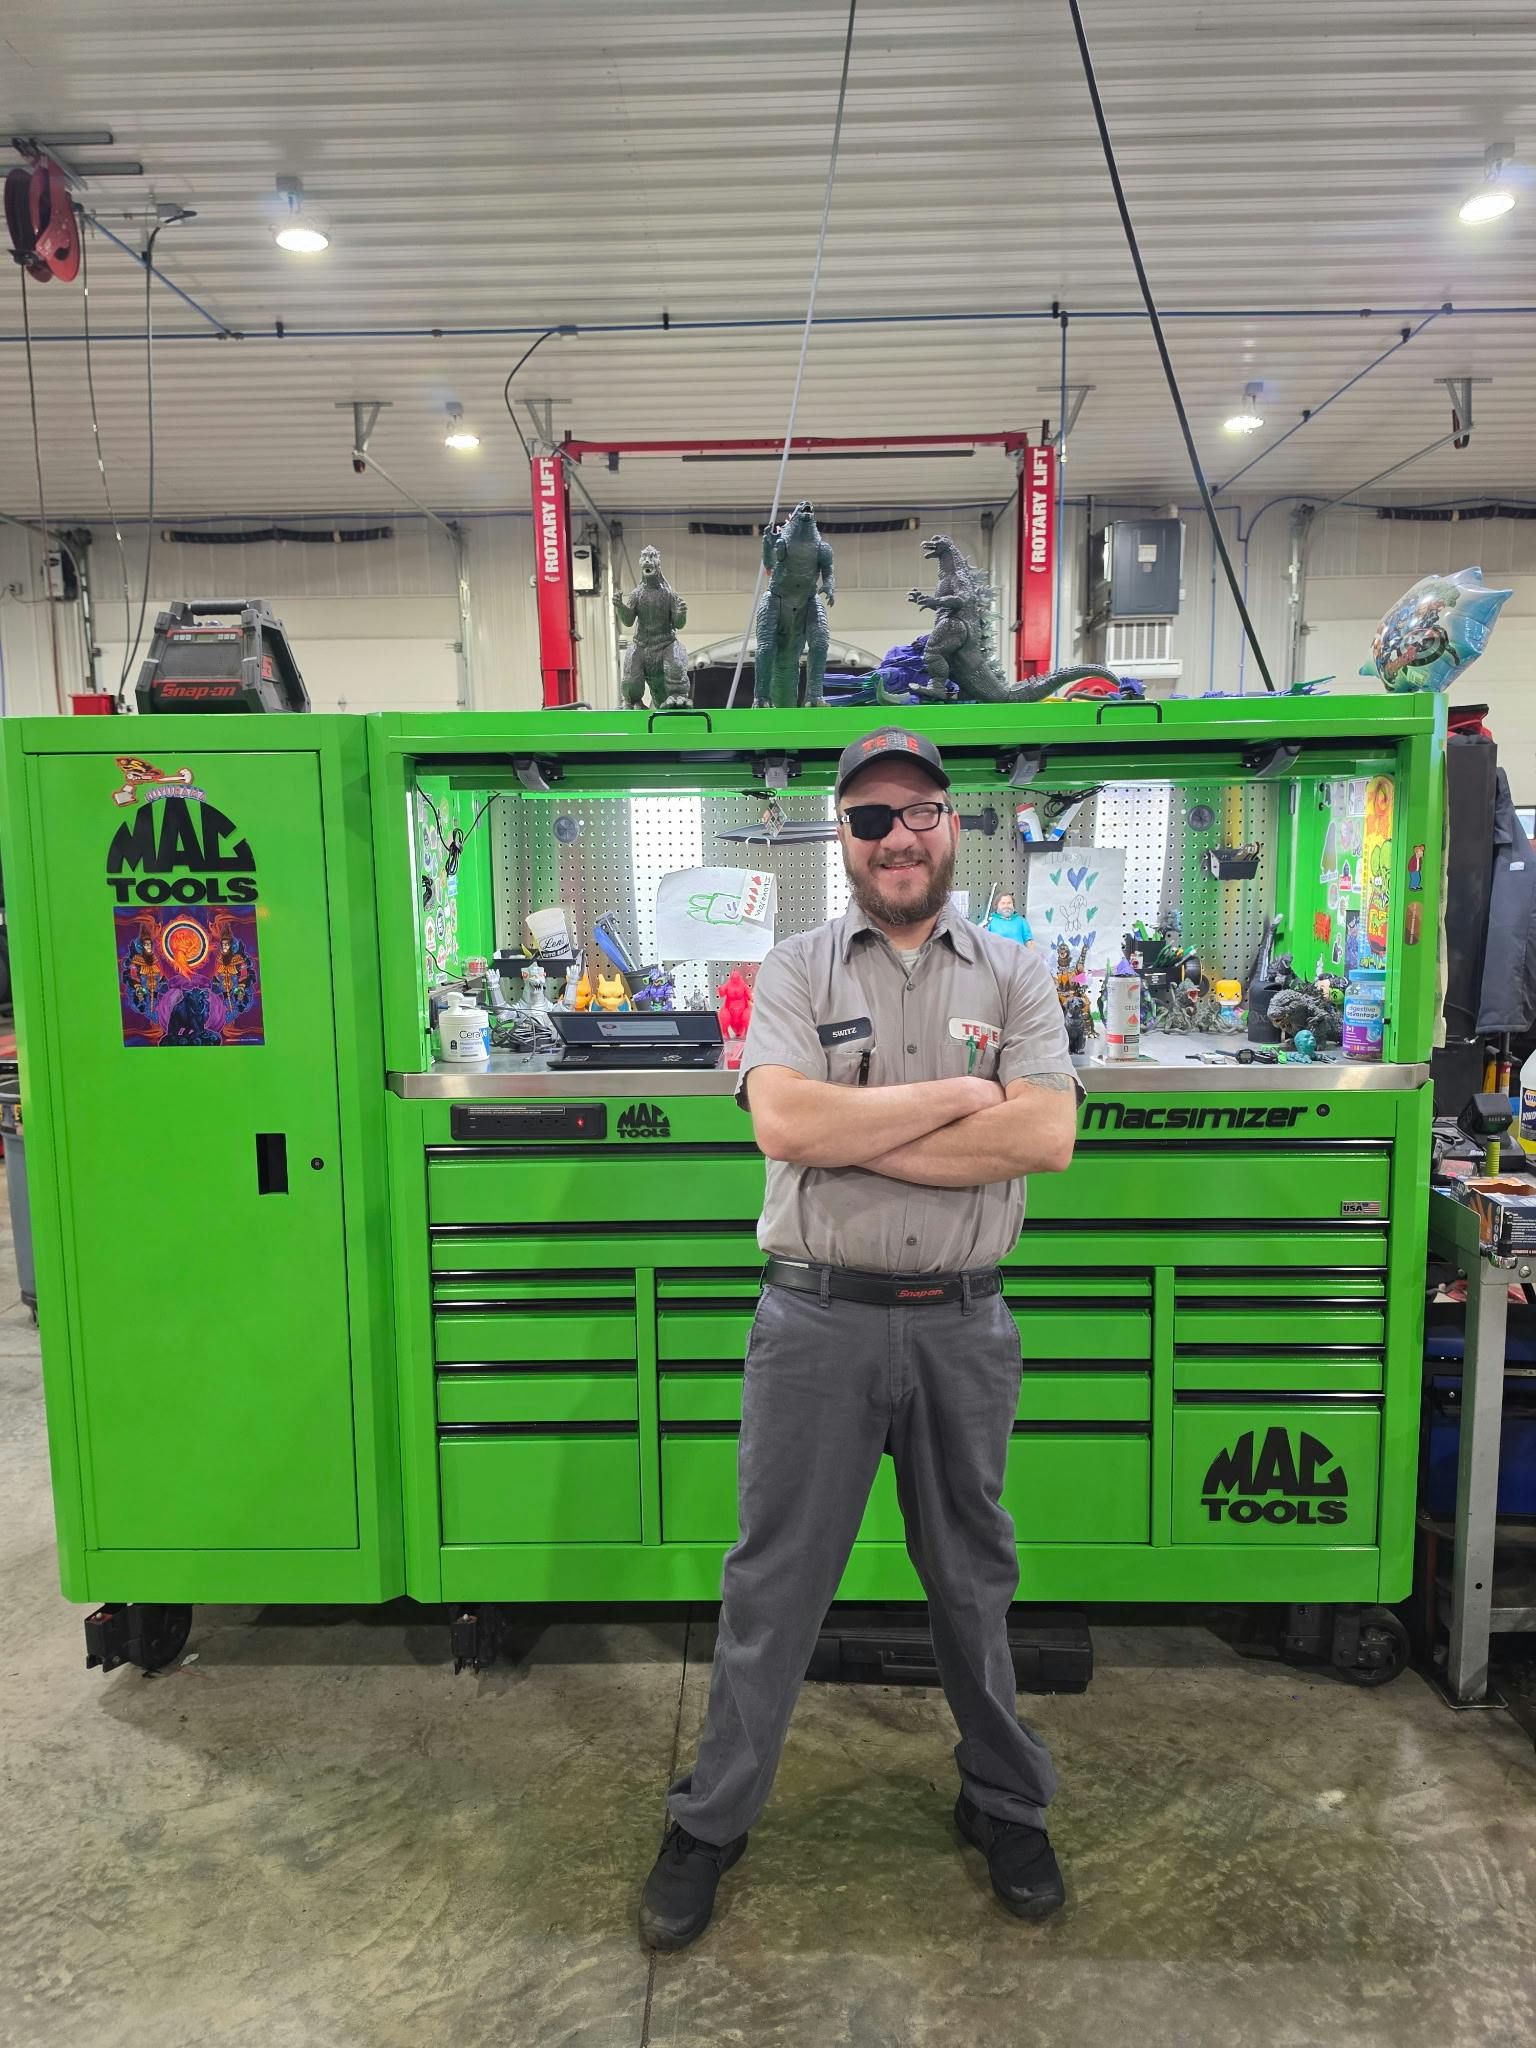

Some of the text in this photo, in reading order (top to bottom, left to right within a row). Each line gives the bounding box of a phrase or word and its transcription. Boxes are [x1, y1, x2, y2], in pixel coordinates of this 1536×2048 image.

[540, 458, 560, 573] ROTARY LIFT
[1031, 448, 1048, 563] ROTARY LIFT
[161, 684, 237, 700] Snap-on
[106, 797, 257, 873] MAC
[106, 877, 259, 904] TOOLS
[832, 1026, 858, 1039] SWITZ
[616, 1102, 671, 1128] MAC
[1082, 1102, 1309, 1130] Macsimizer
[616, 1128, 671, 1138] TOOLS
[898, 1288, 945, 1298] Snap-on
[1201, 1426, 1349, 1497] MAC
[1200, 1498, 1348, 1525] TOOLS
